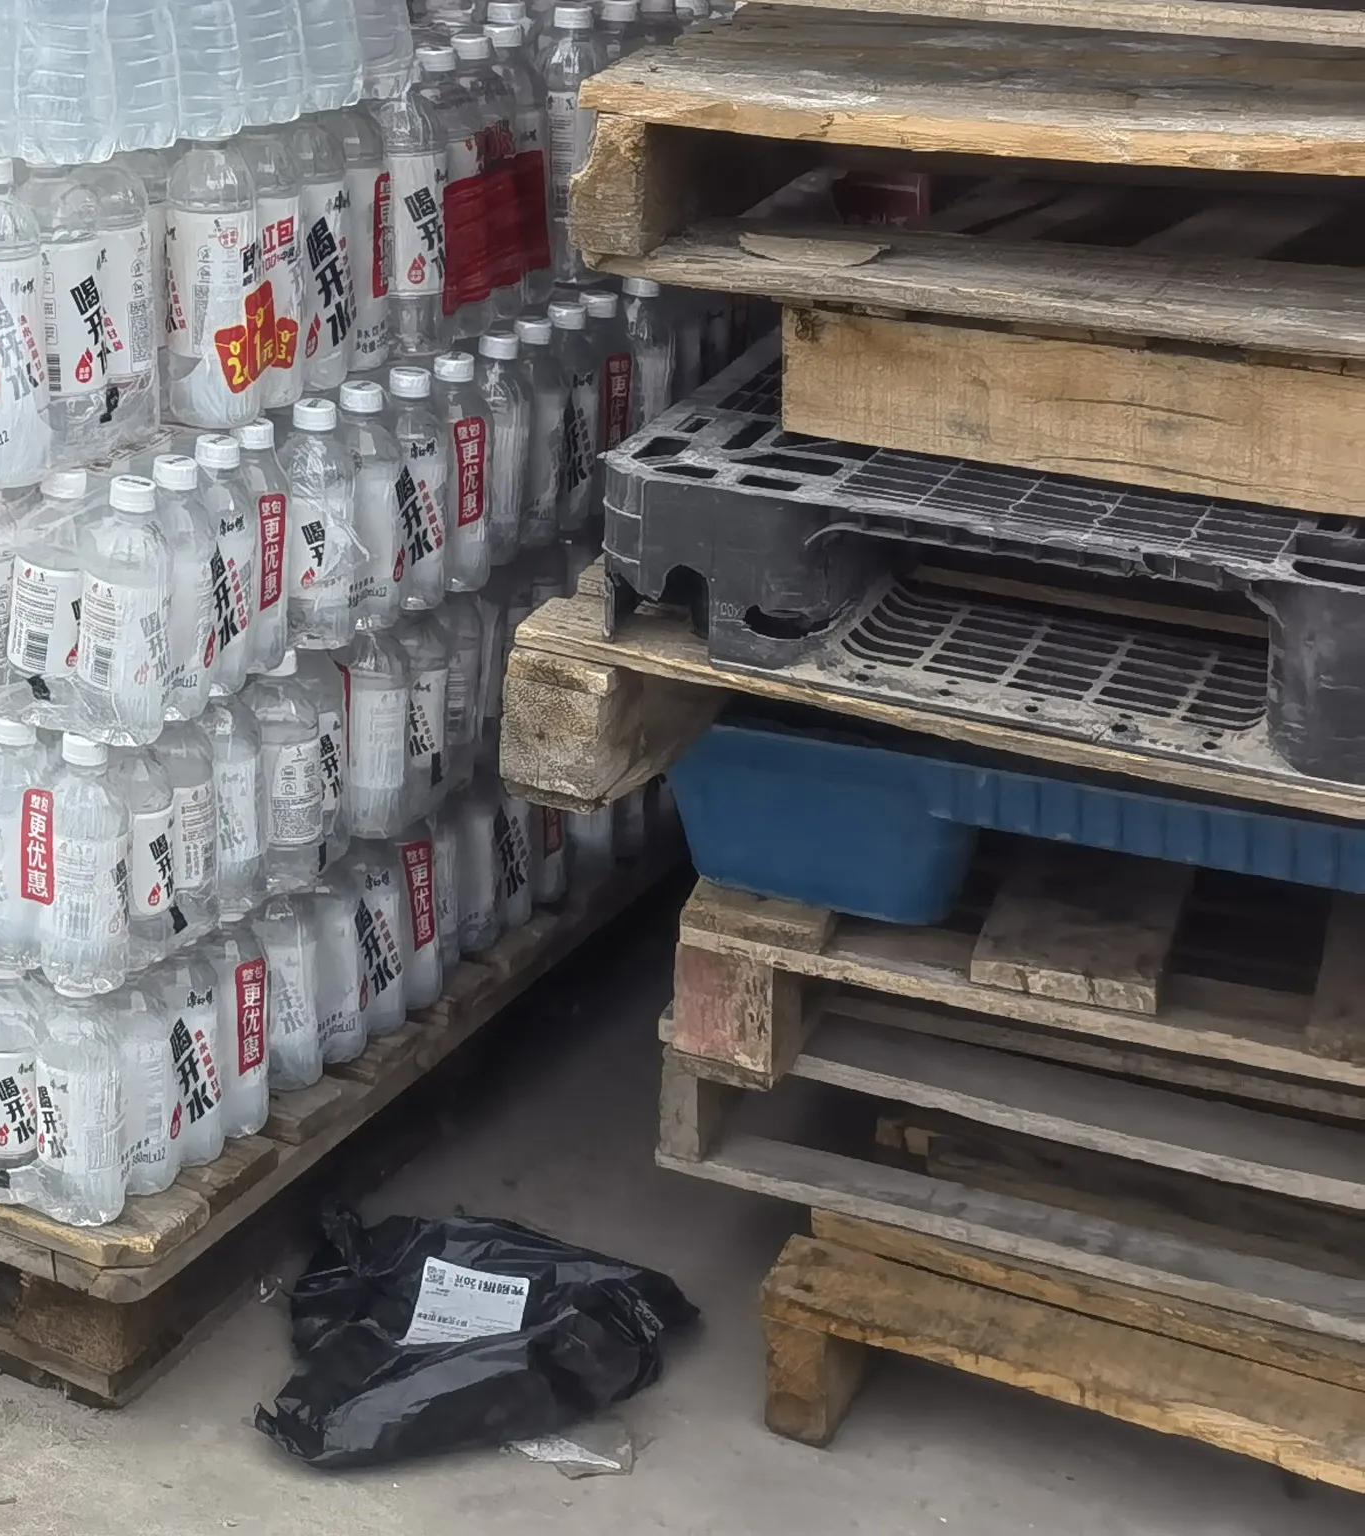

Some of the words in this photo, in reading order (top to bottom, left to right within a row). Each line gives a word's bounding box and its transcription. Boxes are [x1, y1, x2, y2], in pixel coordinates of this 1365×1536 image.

[306, 216, 352, 348] 喝开水
[459, 442, 481, 520] 更优惠
[261, 517, 280, 603] 更优惠
[26, 812, 49, 898] 更优惠
[410, 864, 432, 943] 更优惠
[354, 897, 391, 997] 喝开水
[242, 982, 262, 1066] 更优惠
[169, 1018, 215, 1123] 喝开水
